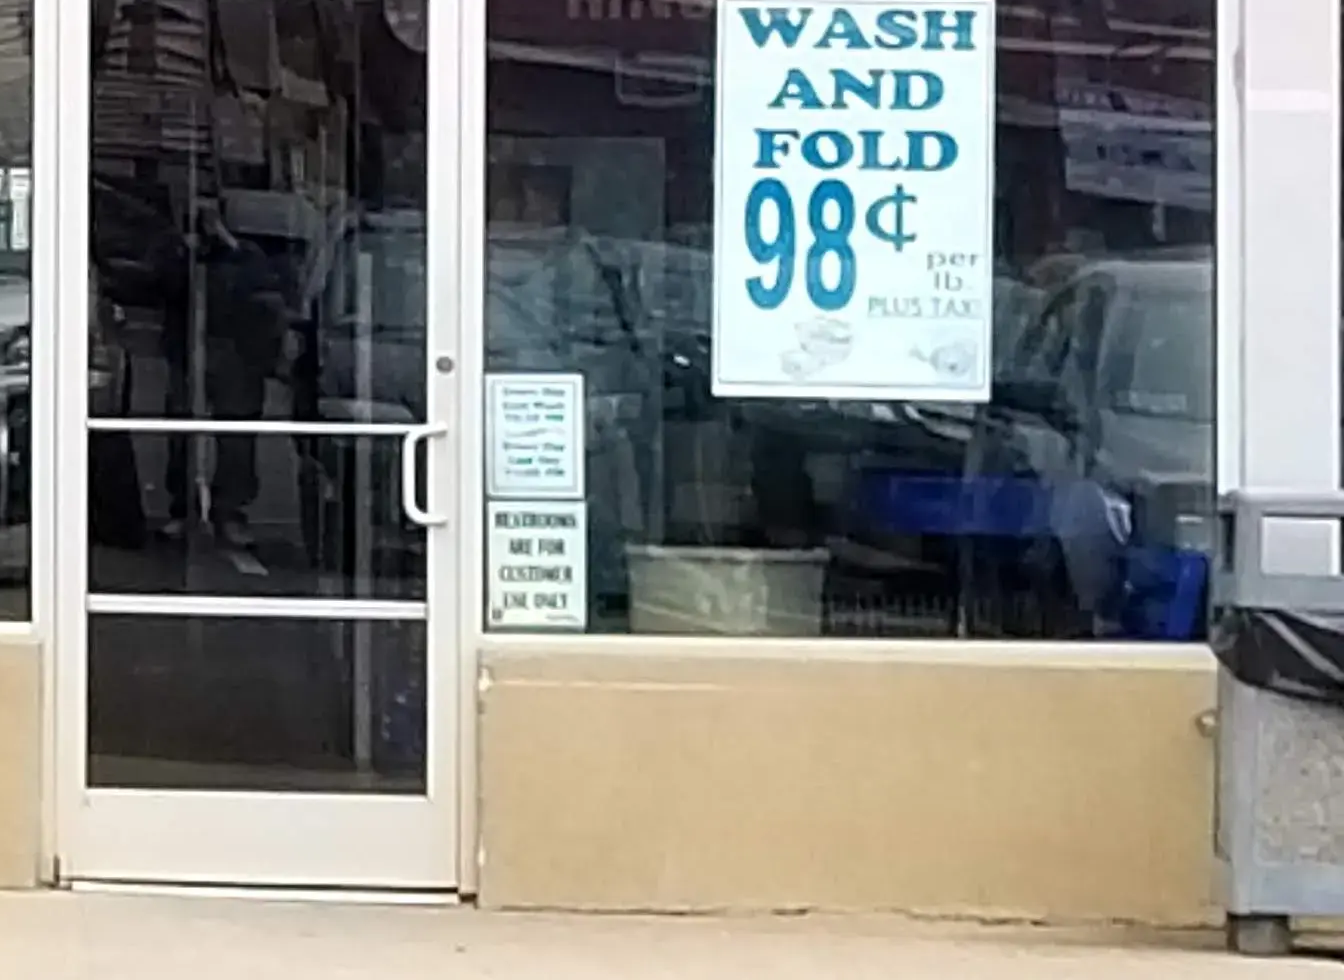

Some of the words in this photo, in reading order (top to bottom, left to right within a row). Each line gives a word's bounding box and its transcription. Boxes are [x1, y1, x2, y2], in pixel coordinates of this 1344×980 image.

[737, 6, 978, 52] WASH
[766, 68, 945, 111] AND
[752, 128, 960, 173] FOLD
[926, 250, 980, 270] per
[867, 295, 923, 318] PLUS
